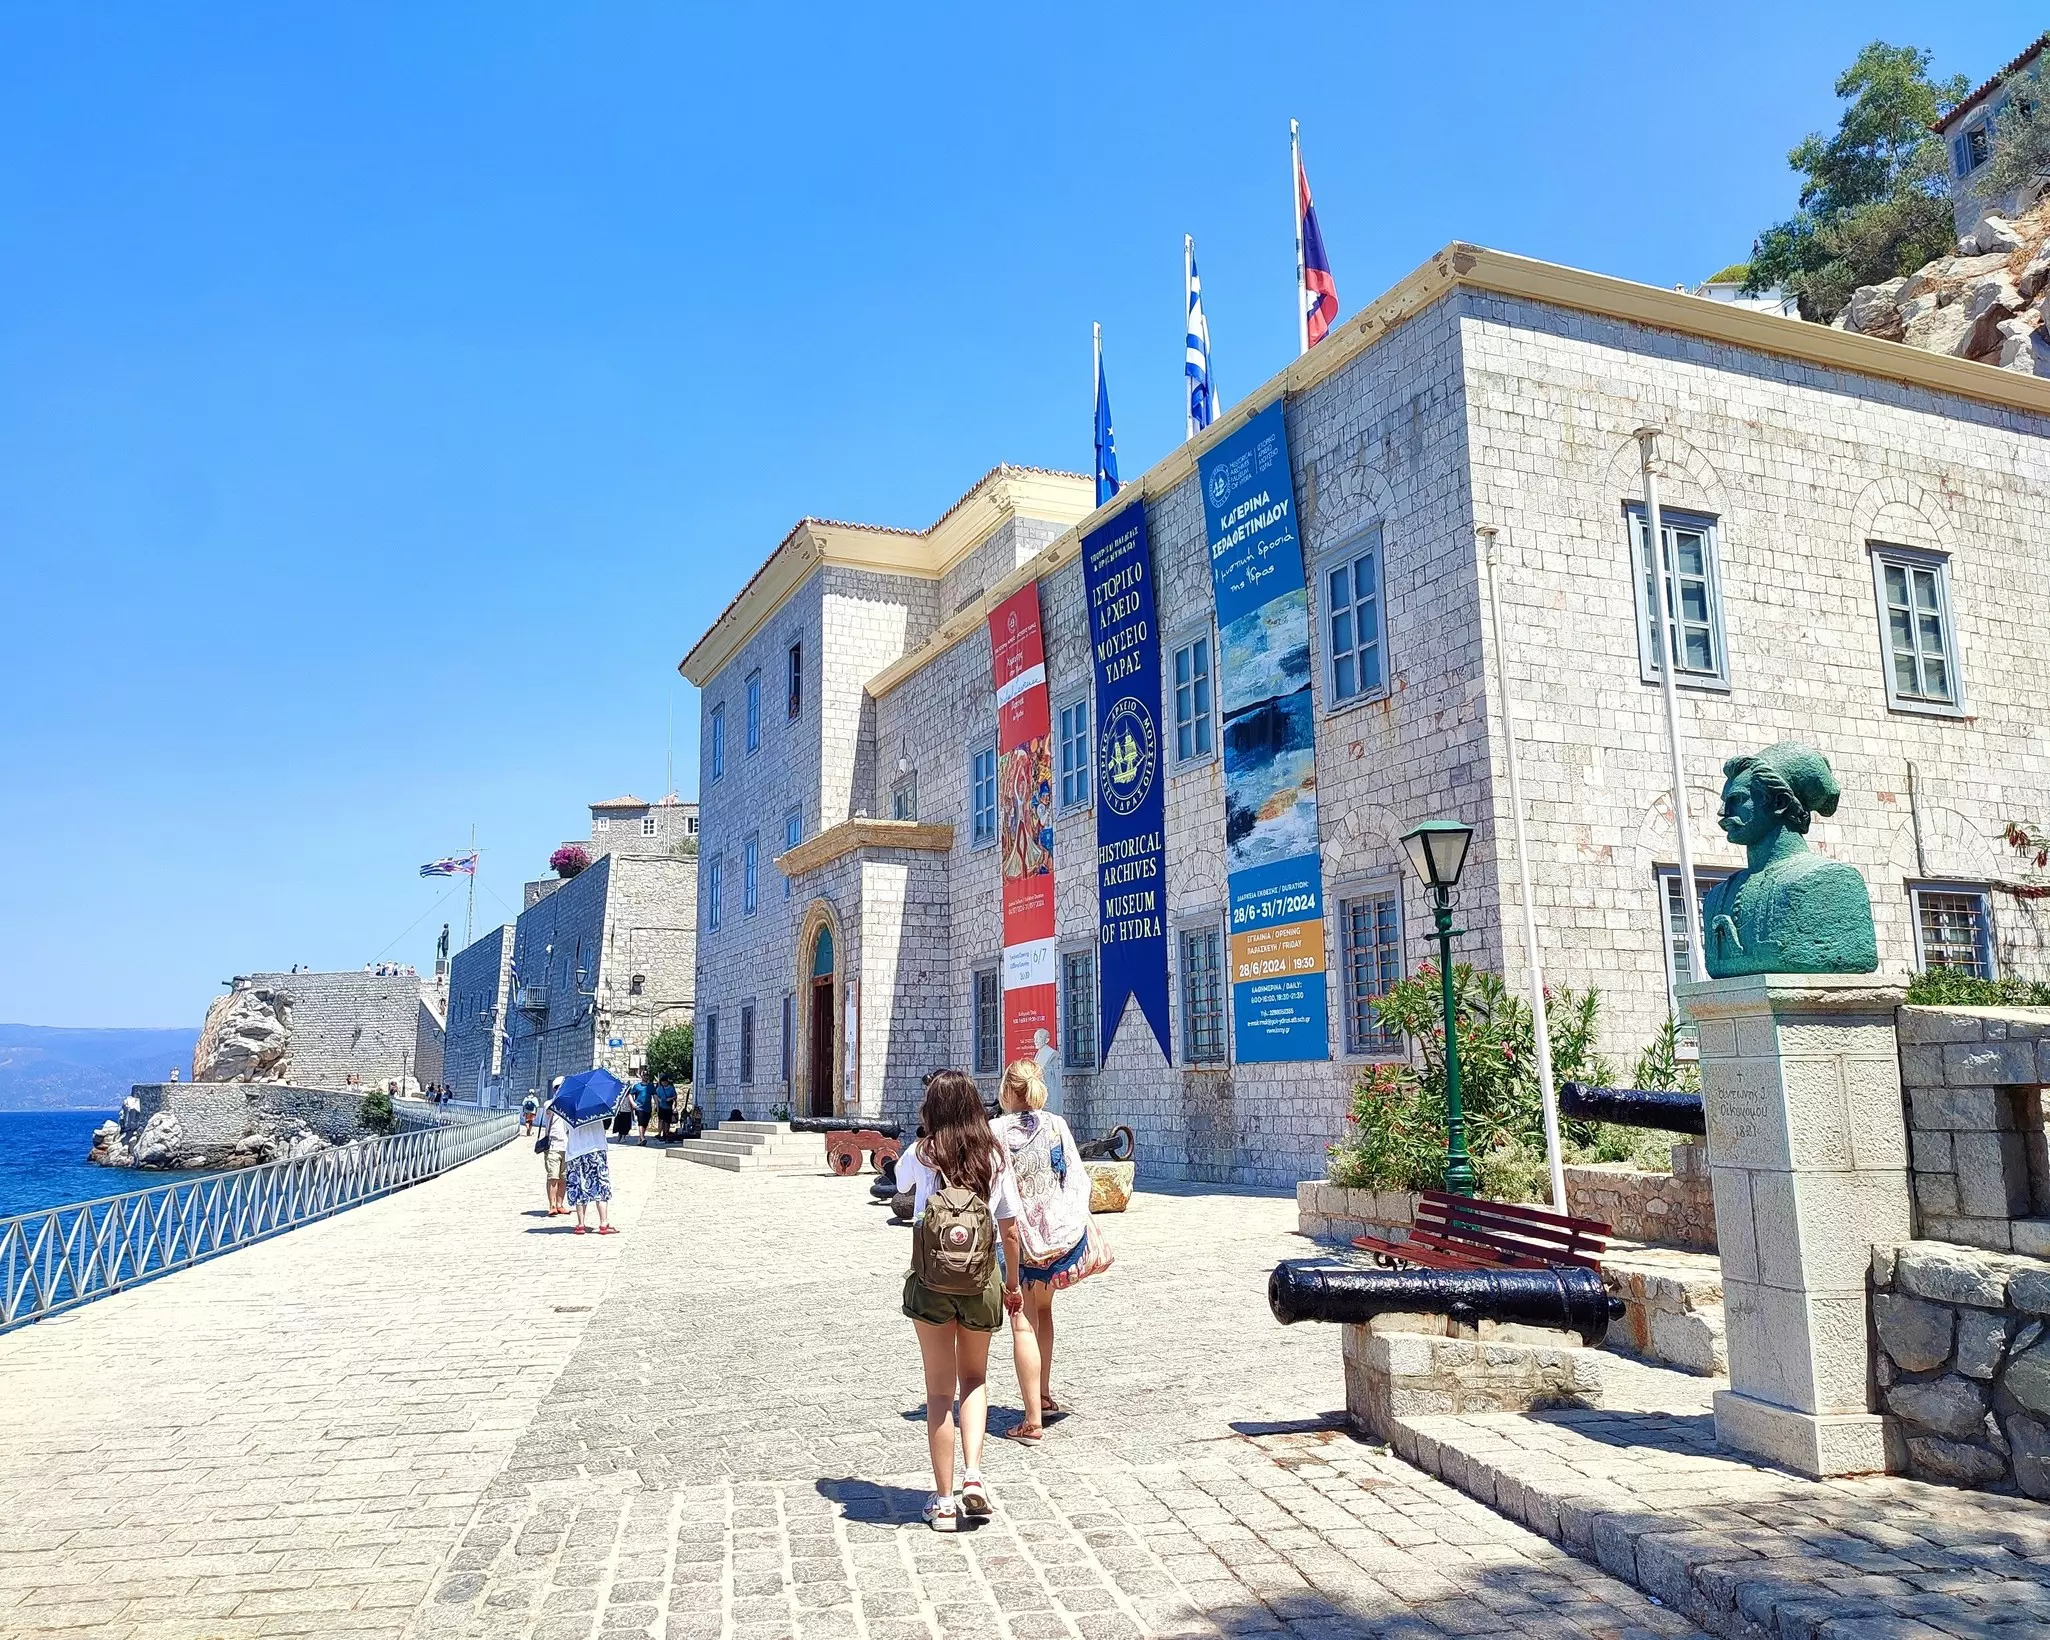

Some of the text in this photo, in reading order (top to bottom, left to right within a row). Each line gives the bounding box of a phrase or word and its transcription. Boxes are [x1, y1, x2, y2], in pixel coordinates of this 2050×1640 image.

[1092, 562, 1142, 608] ΙΣΤΟΡΙΚΟ
[1100, 591, 1140, 630] ΑΡΧΕΙΟ
[1098, 620, 1147, 664] ΜΟΥΣΕΙΟ
[1106, 650, 1141, 684] ΥΔΡΑΣ
[1098, 832, 1161, 864] HISTORICAL
[1104, 857, 1156, 887] ARCHIVES
[1106, 890, 1155, 918] MUSEUM
[1234, 904, 1255, 924] 28/6
[1261, 893, 1315, 918] 31/7/2024
[1102, 916, 1161, 944] OF HYDRA
[1275, 927, 1300, 938] OPENING
[1282, 940, 1302, 950] FRIDAY
[1240, 956, 1314, 978] 28/6/2024 19:30
